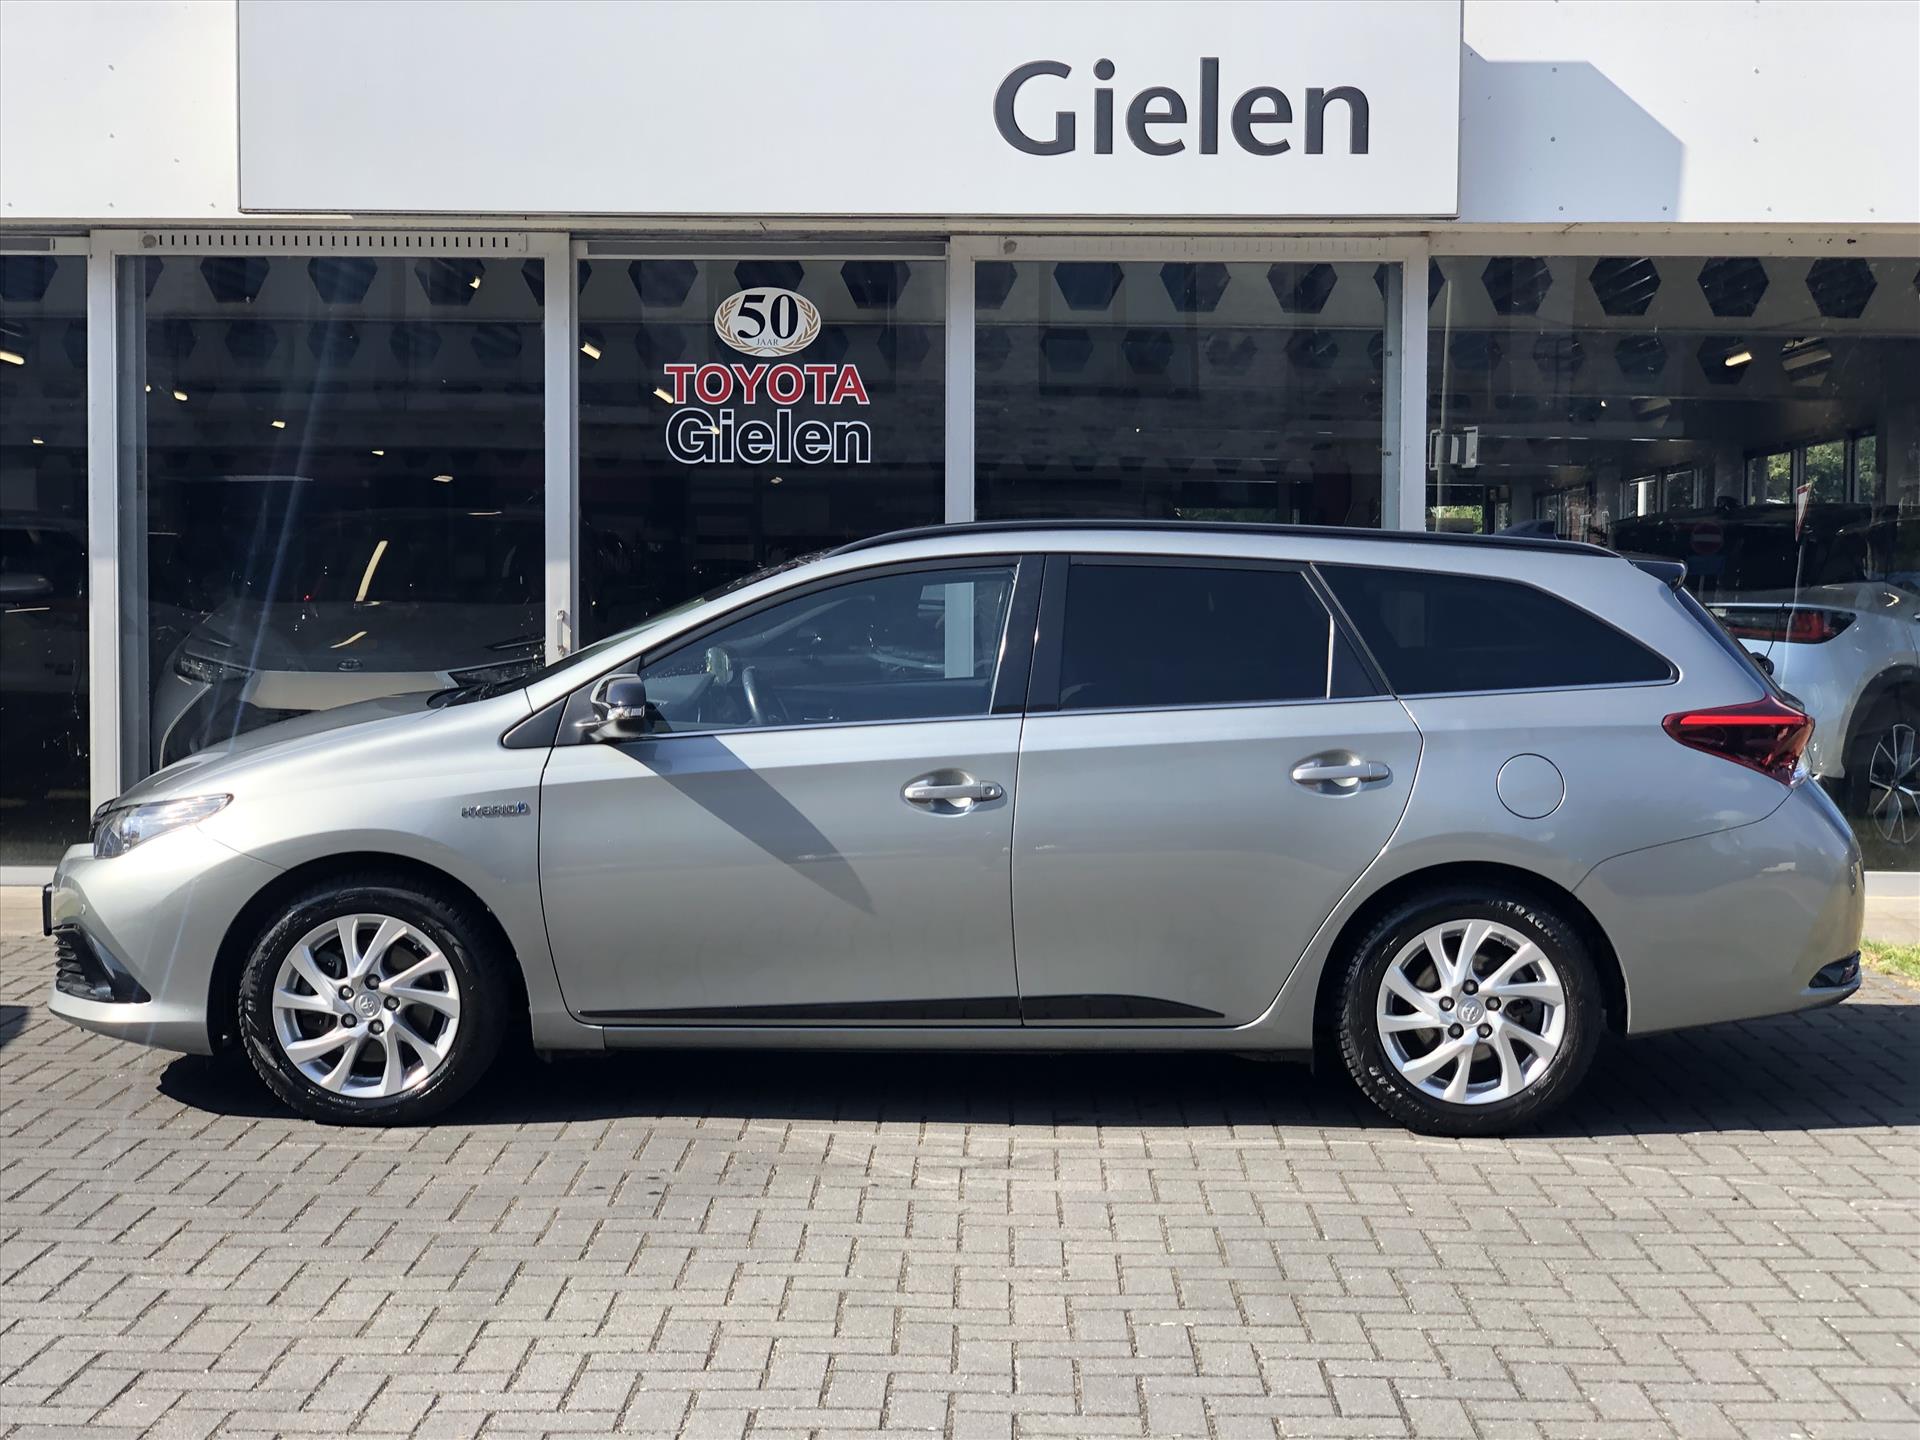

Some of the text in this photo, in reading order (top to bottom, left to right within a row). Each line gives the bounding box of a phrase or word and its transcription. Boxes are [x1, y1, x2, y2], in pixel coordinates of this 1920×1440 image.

[992, 57, 1370, 156] Gielen
[737, 294, 799, 339] 50
[756, 338, 779, 347] JAAR
[664, 363, 870, 405] TOYOTA
[666, 407, 871, 464] Gielen
